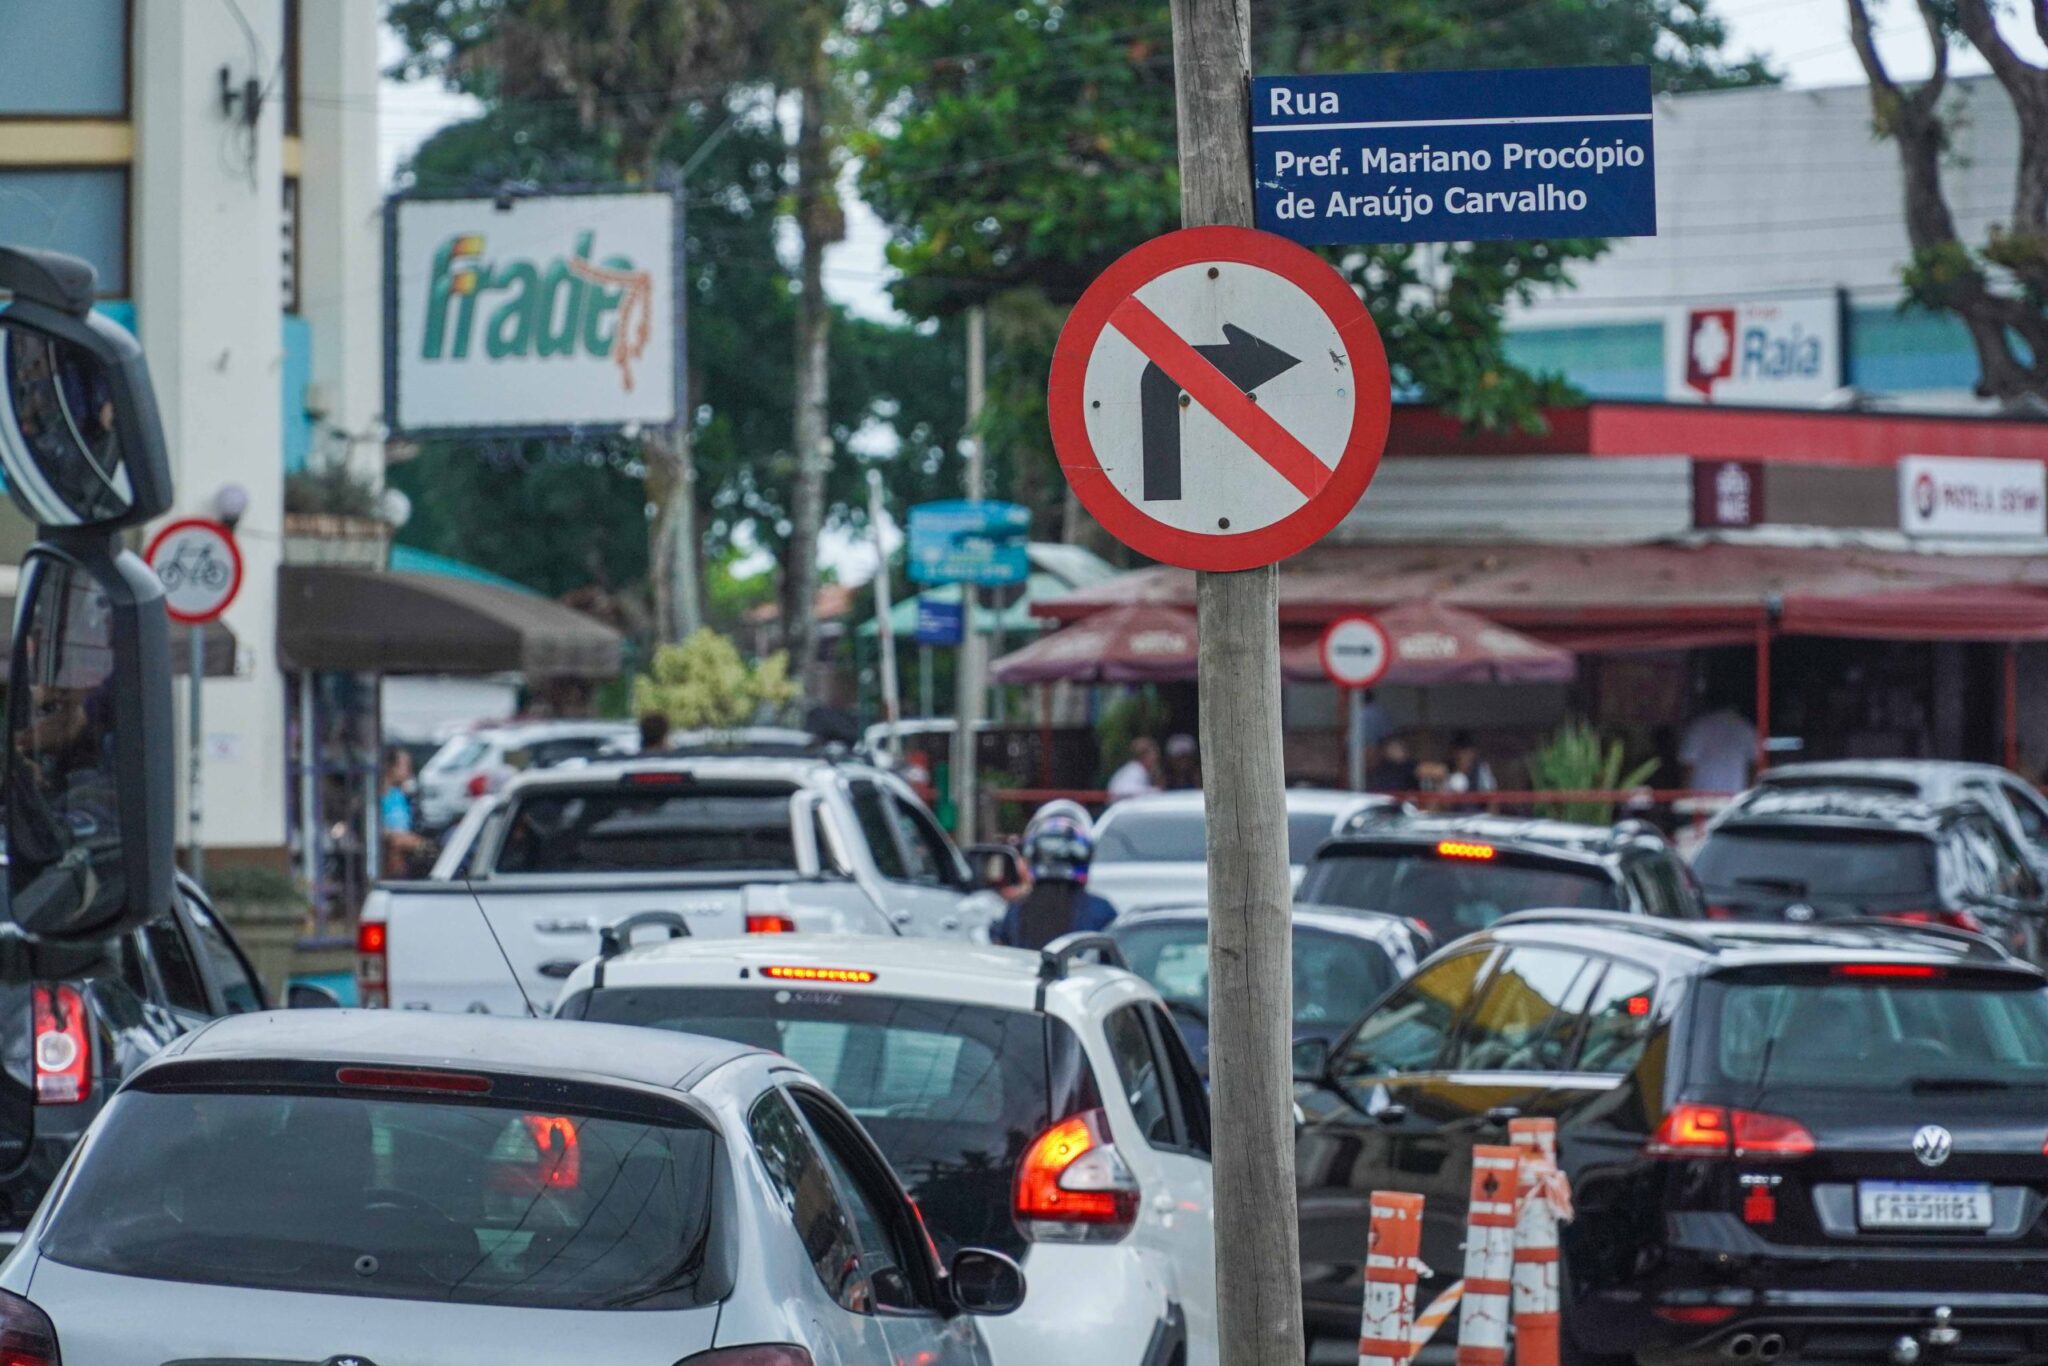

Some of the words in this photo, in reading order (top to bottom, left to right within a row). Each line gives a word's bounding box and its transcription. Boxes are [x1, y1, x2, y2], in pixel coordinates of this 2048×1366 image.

[1270, 87, 1340, 116] Rua
[1275, 147, 1349, 177] Pref.
[1361, 144, 1492, 175] Mariano
[1503, 137, 1645, 175] Procópio
[1275, 191, 1316, 220] de
[1325, 185, 1434, 223] Araújo
[1444, 183, 1588, 215] Carvalho
[1741, 322, 1822, 379] Raia
